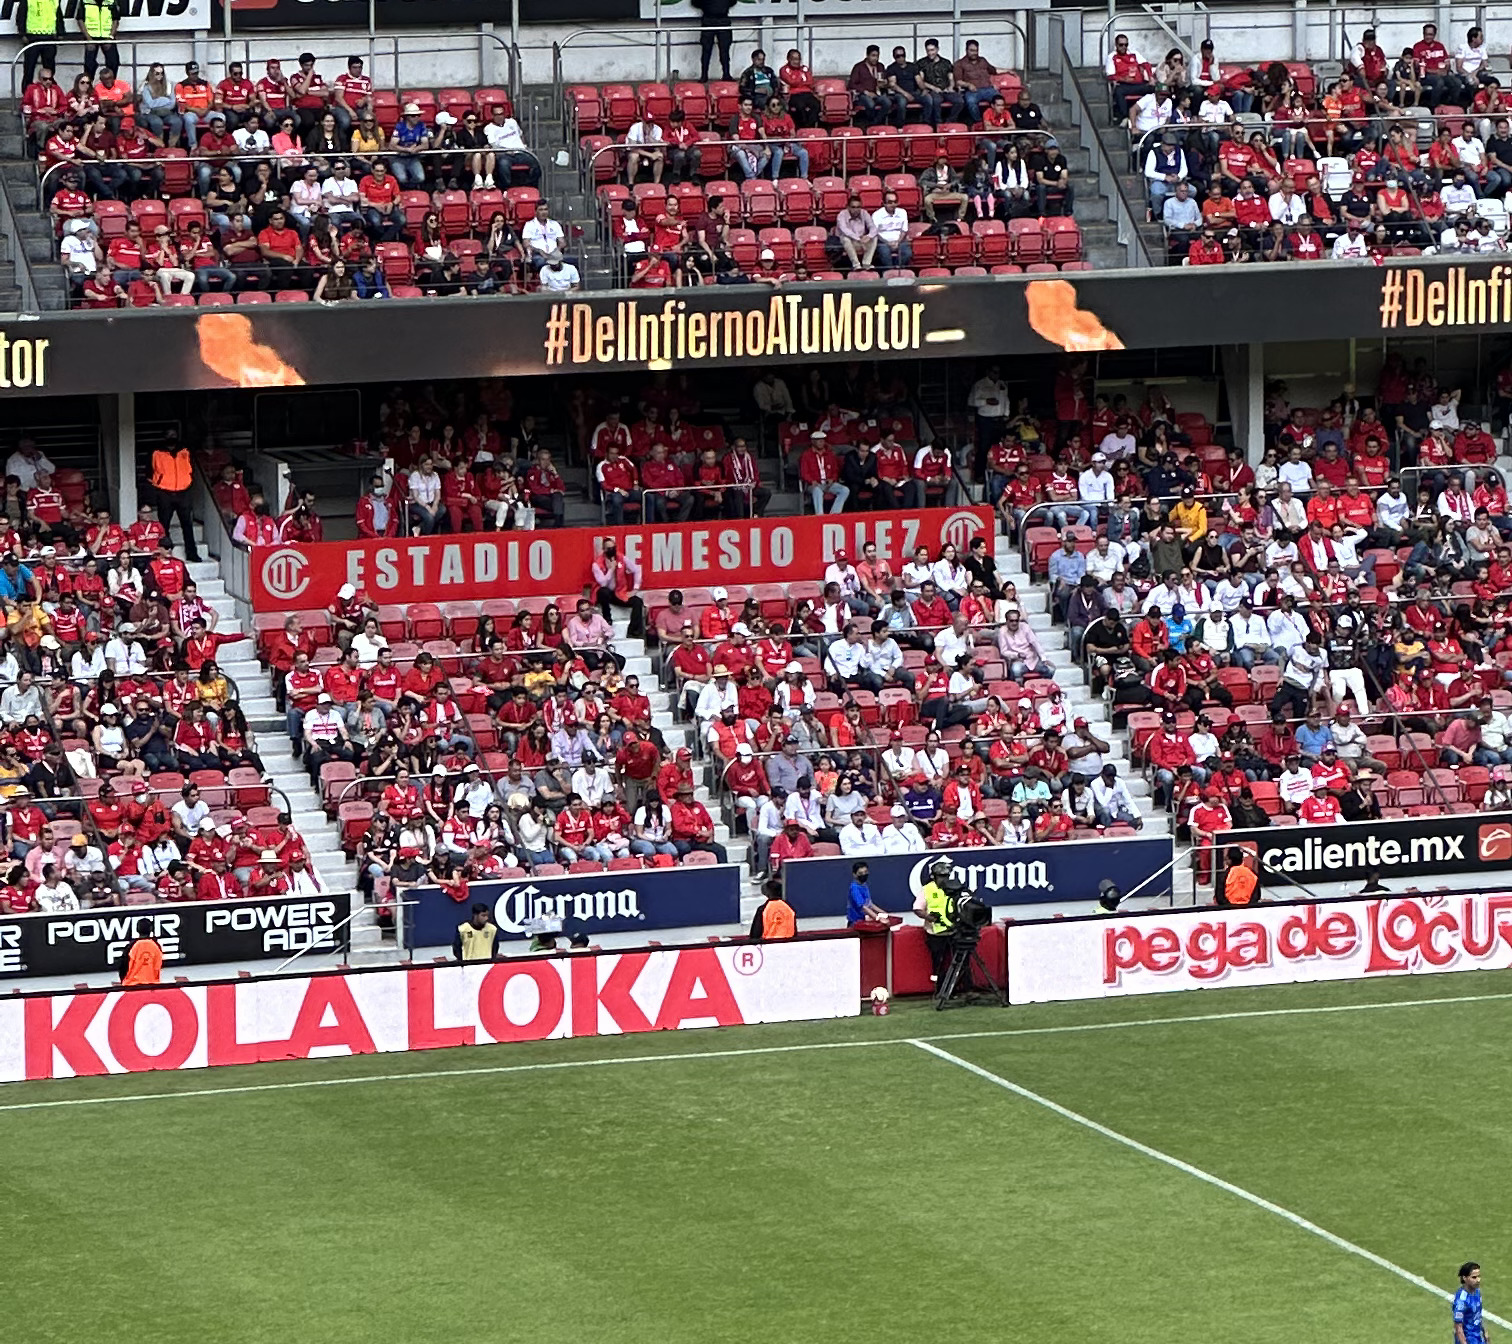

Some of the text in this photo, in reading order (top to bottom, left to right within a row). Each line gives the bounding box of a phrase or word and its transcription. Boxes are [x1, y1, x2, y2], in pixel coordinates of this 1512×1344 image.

[346, 538, 554, 592] ESTADIO
[594, 525, 795, 573] EMESIO
[823, 518, 922, 563] DIEZ
[1262, 833, 1465, 873] caliente.mx
[206, 901, 336, 933] POWER
[494, 885, 640, 935] Corona
[263, 924, 335, 953] ADE
[1103, 914, 1270, 984] pega
[1277, 903, 1359, 957] de
[24, 974, 377, 1080] KOLA
[407, 947, 746, 1051] LOKA
